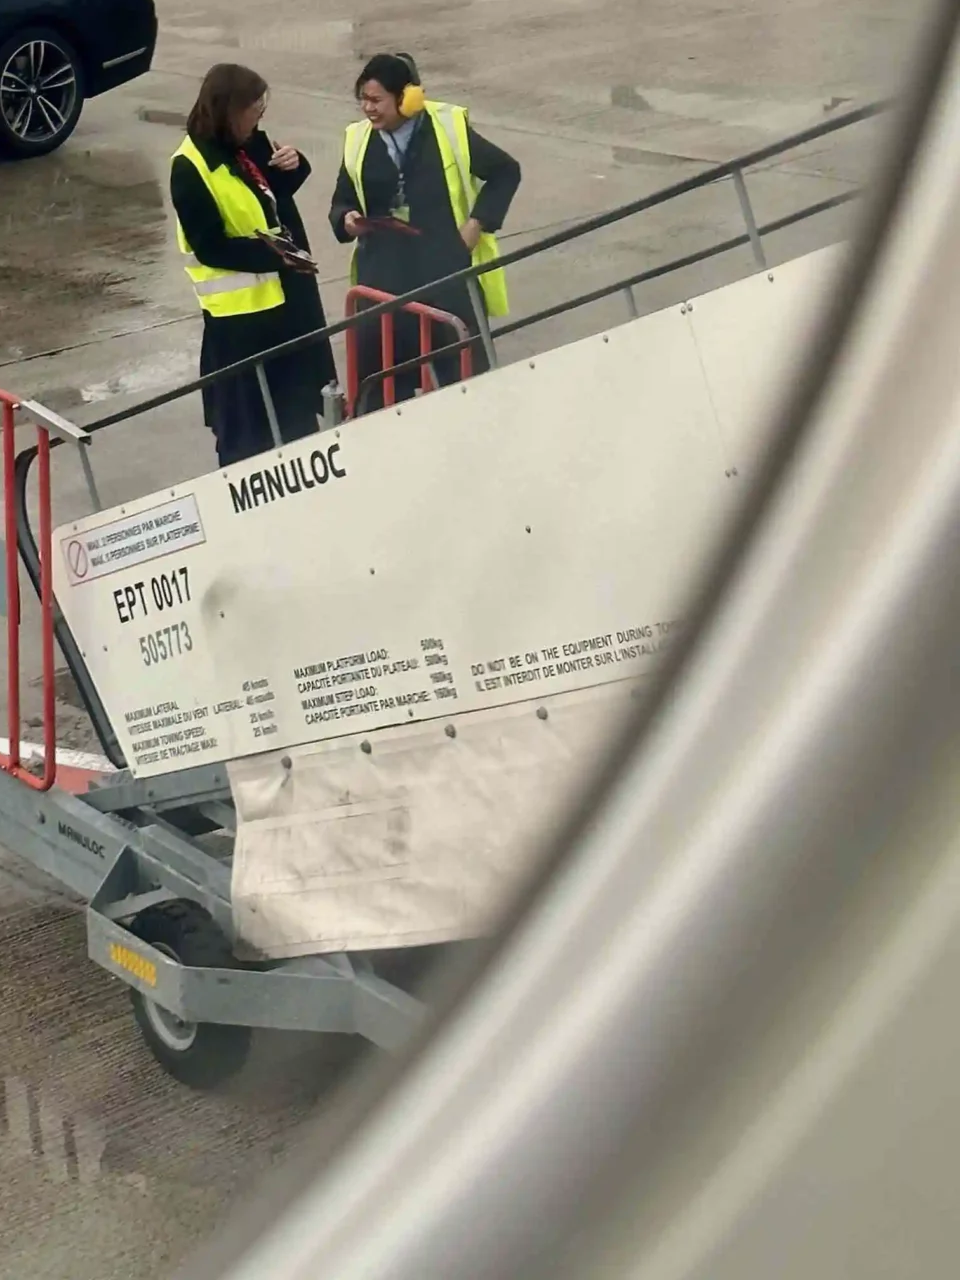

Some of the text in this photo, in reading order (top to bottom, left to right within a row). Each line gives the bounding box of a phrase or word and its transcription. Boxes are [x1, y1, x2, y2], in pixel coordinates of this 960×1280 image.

[228, 443, 346, 514] MANULOC
[142, 521, 154, 531] PAR
[155, 511, 182, 526] MARCHE
[113, 567, 192, 624] EPT 0017
[139, 621, 194, 667] 505773
[470, 664, 485, 676] DO
[487, 659, 507, 672] NOT
[509, 656, 523, 667] BE
[525, 652, 539, 663] ON
[541, 647, 560, 660] THE
[563, 634, 614, 656] EQUIPMENT
[616, 625, 652, 644] DURING
[294, 663, 326, 677] MAXIMUM
[327, 654, 366, 670] PLATFORM
[366, 648, 390, 662] LOAD:
[332, 669, 370, 684] PORTANTE
[371, 666, 383, 677] DU
[485, 676, 503, 690] EST
[503, 668, 542, 686] INTERDIT
[543, 665, 556, 677] DE
[557, 656, 594, 675] MONTER
[595, 652, 614, 666] SUR
[153, 701, 179, 714] LATERAL
[301, 695, 335, 709] MAXIMUM
[335, 691, 354, 702] STEP
[355, 685, 378, 698] LOAD:
[340, 701, 379, 717] PORTANTE
[380, 698, 395, 709] PAR
[396, 690, 432, 707] MARCHE:
[183, 712, 192, 721] DU
[193, 707, 209, 718] VENT
[160, 731, 183, 745] TOWING
[169, 741, 200, 757] TRACTAGE
[58, 820, 105, 859] MANULOC
